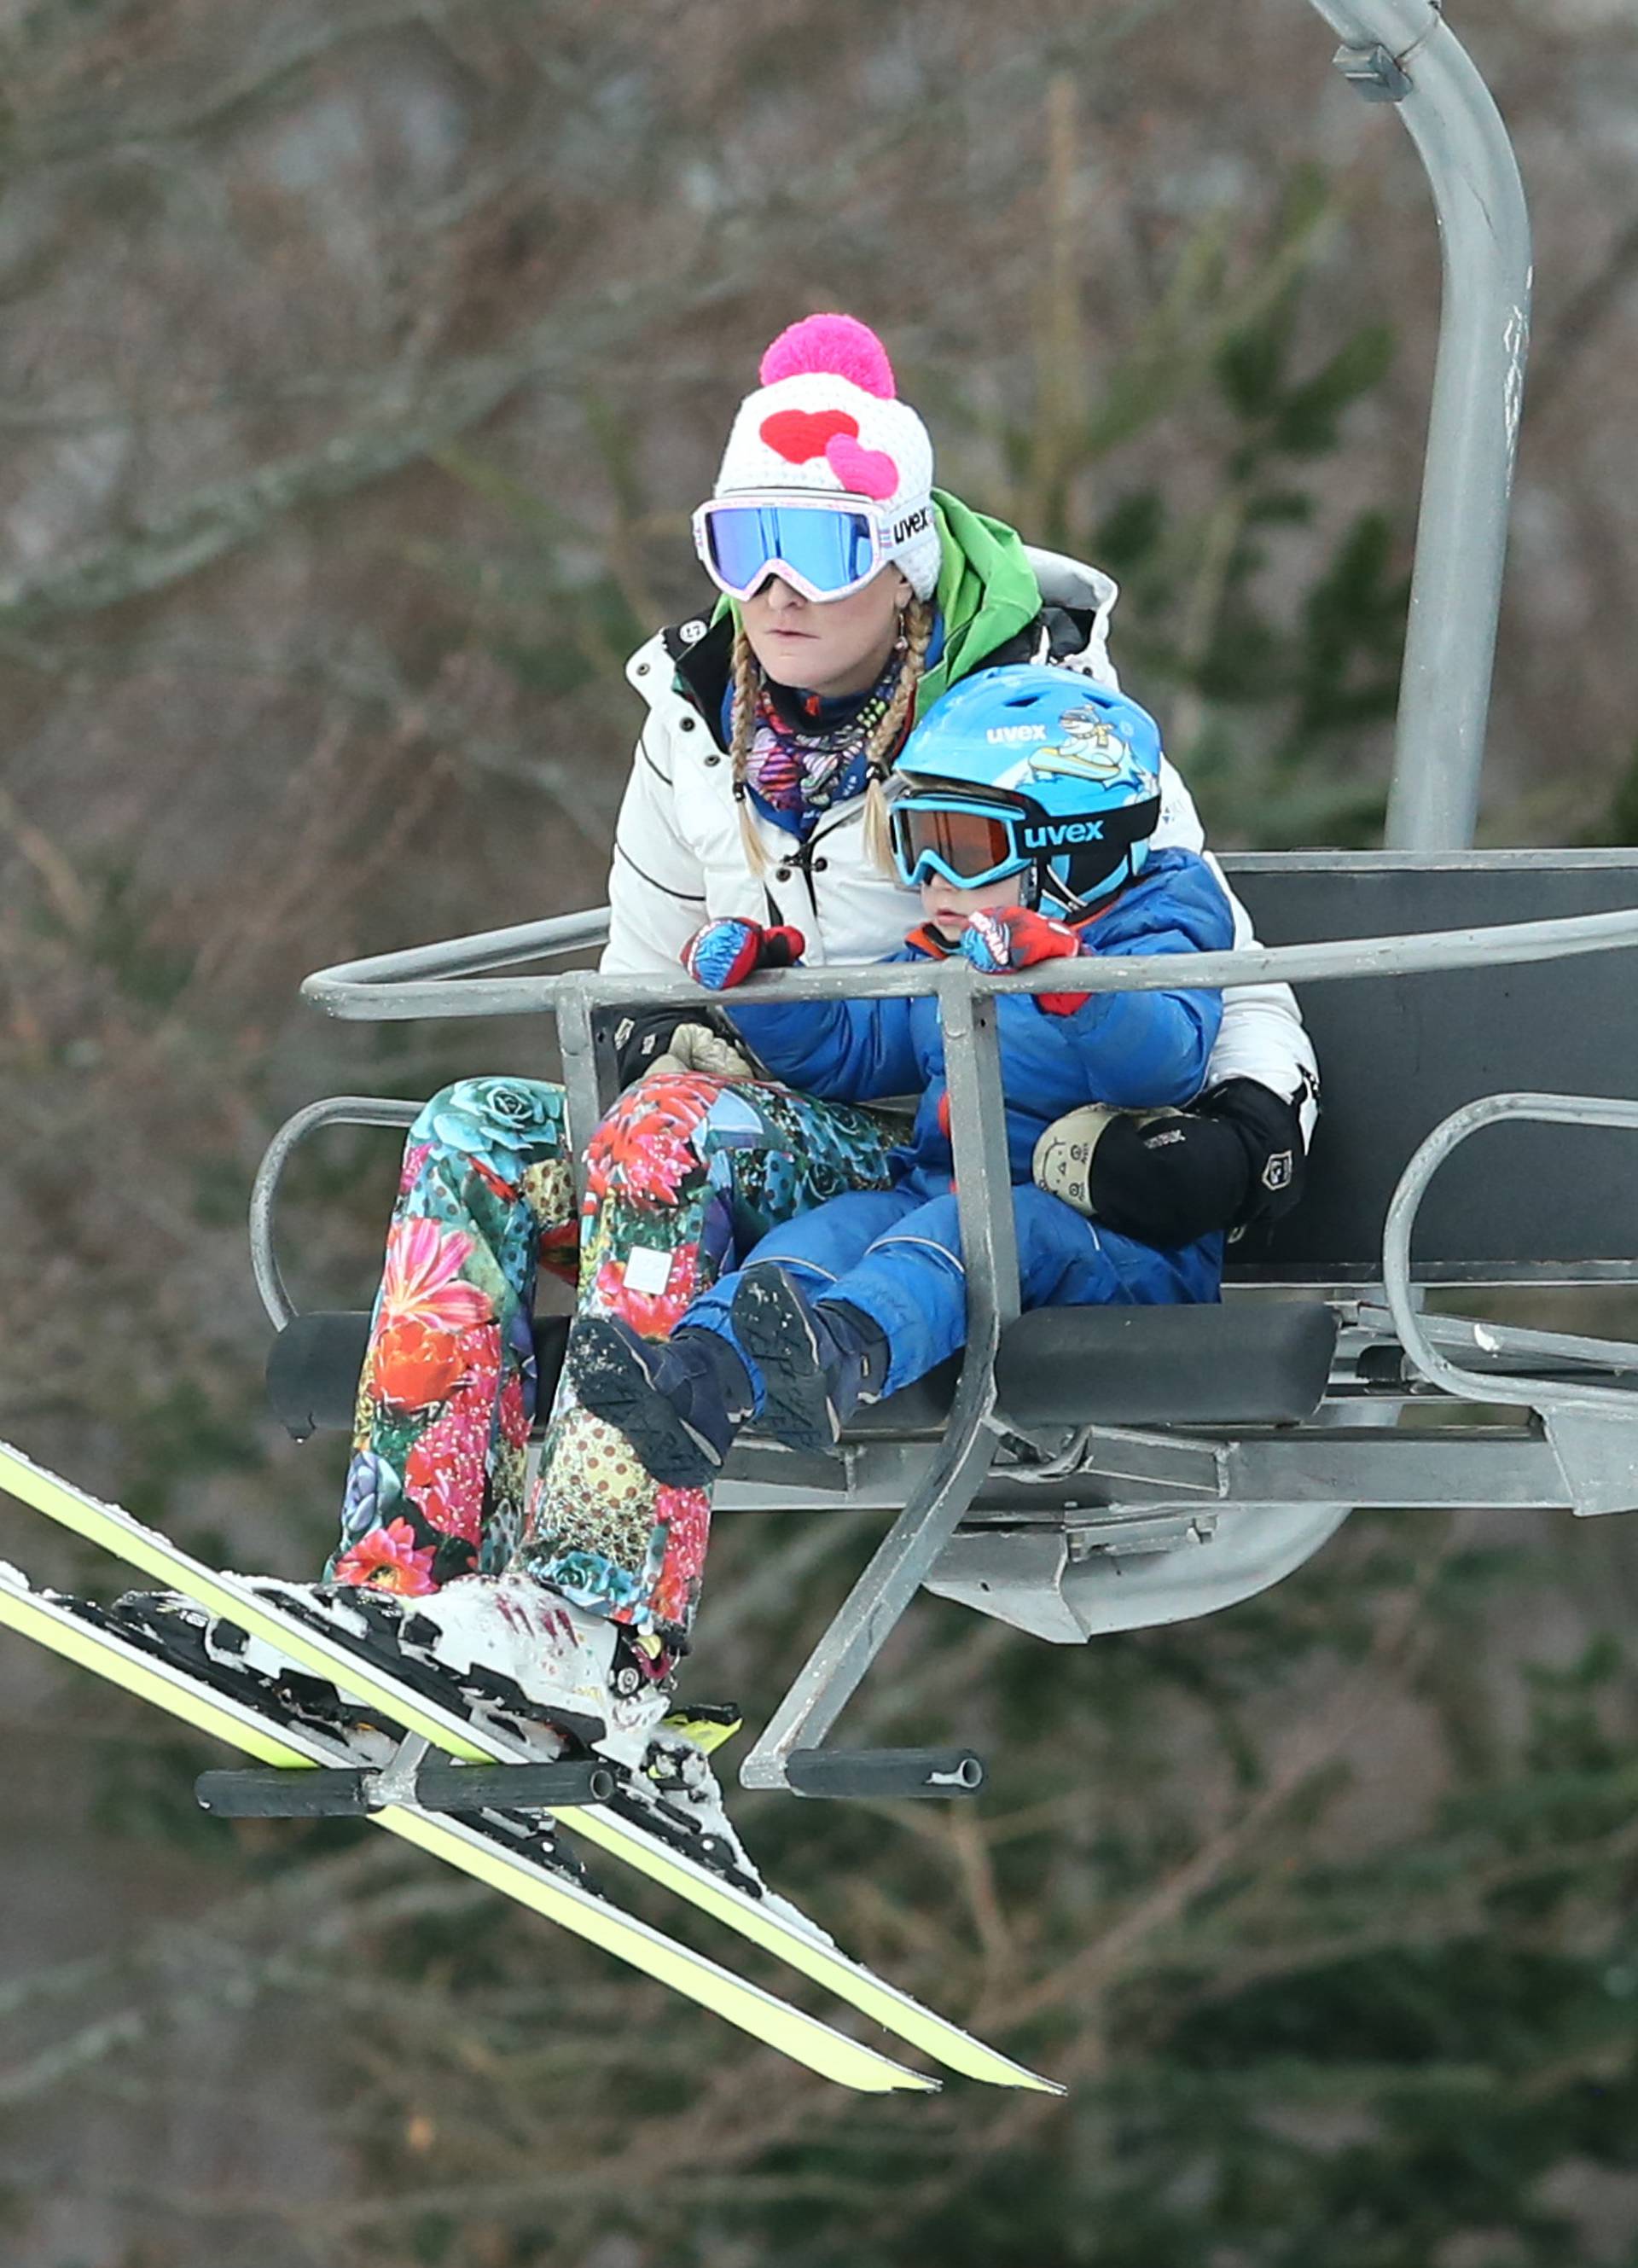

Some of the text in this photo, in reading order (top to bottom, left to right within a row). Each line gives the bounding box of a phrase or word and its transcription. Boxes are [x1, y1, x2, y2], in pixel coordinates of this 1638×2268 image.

[894, 507, 928, 544] uvex
[986, 724, 1047, 744] uvex
[1025, 820, 1104, 848] uvex
